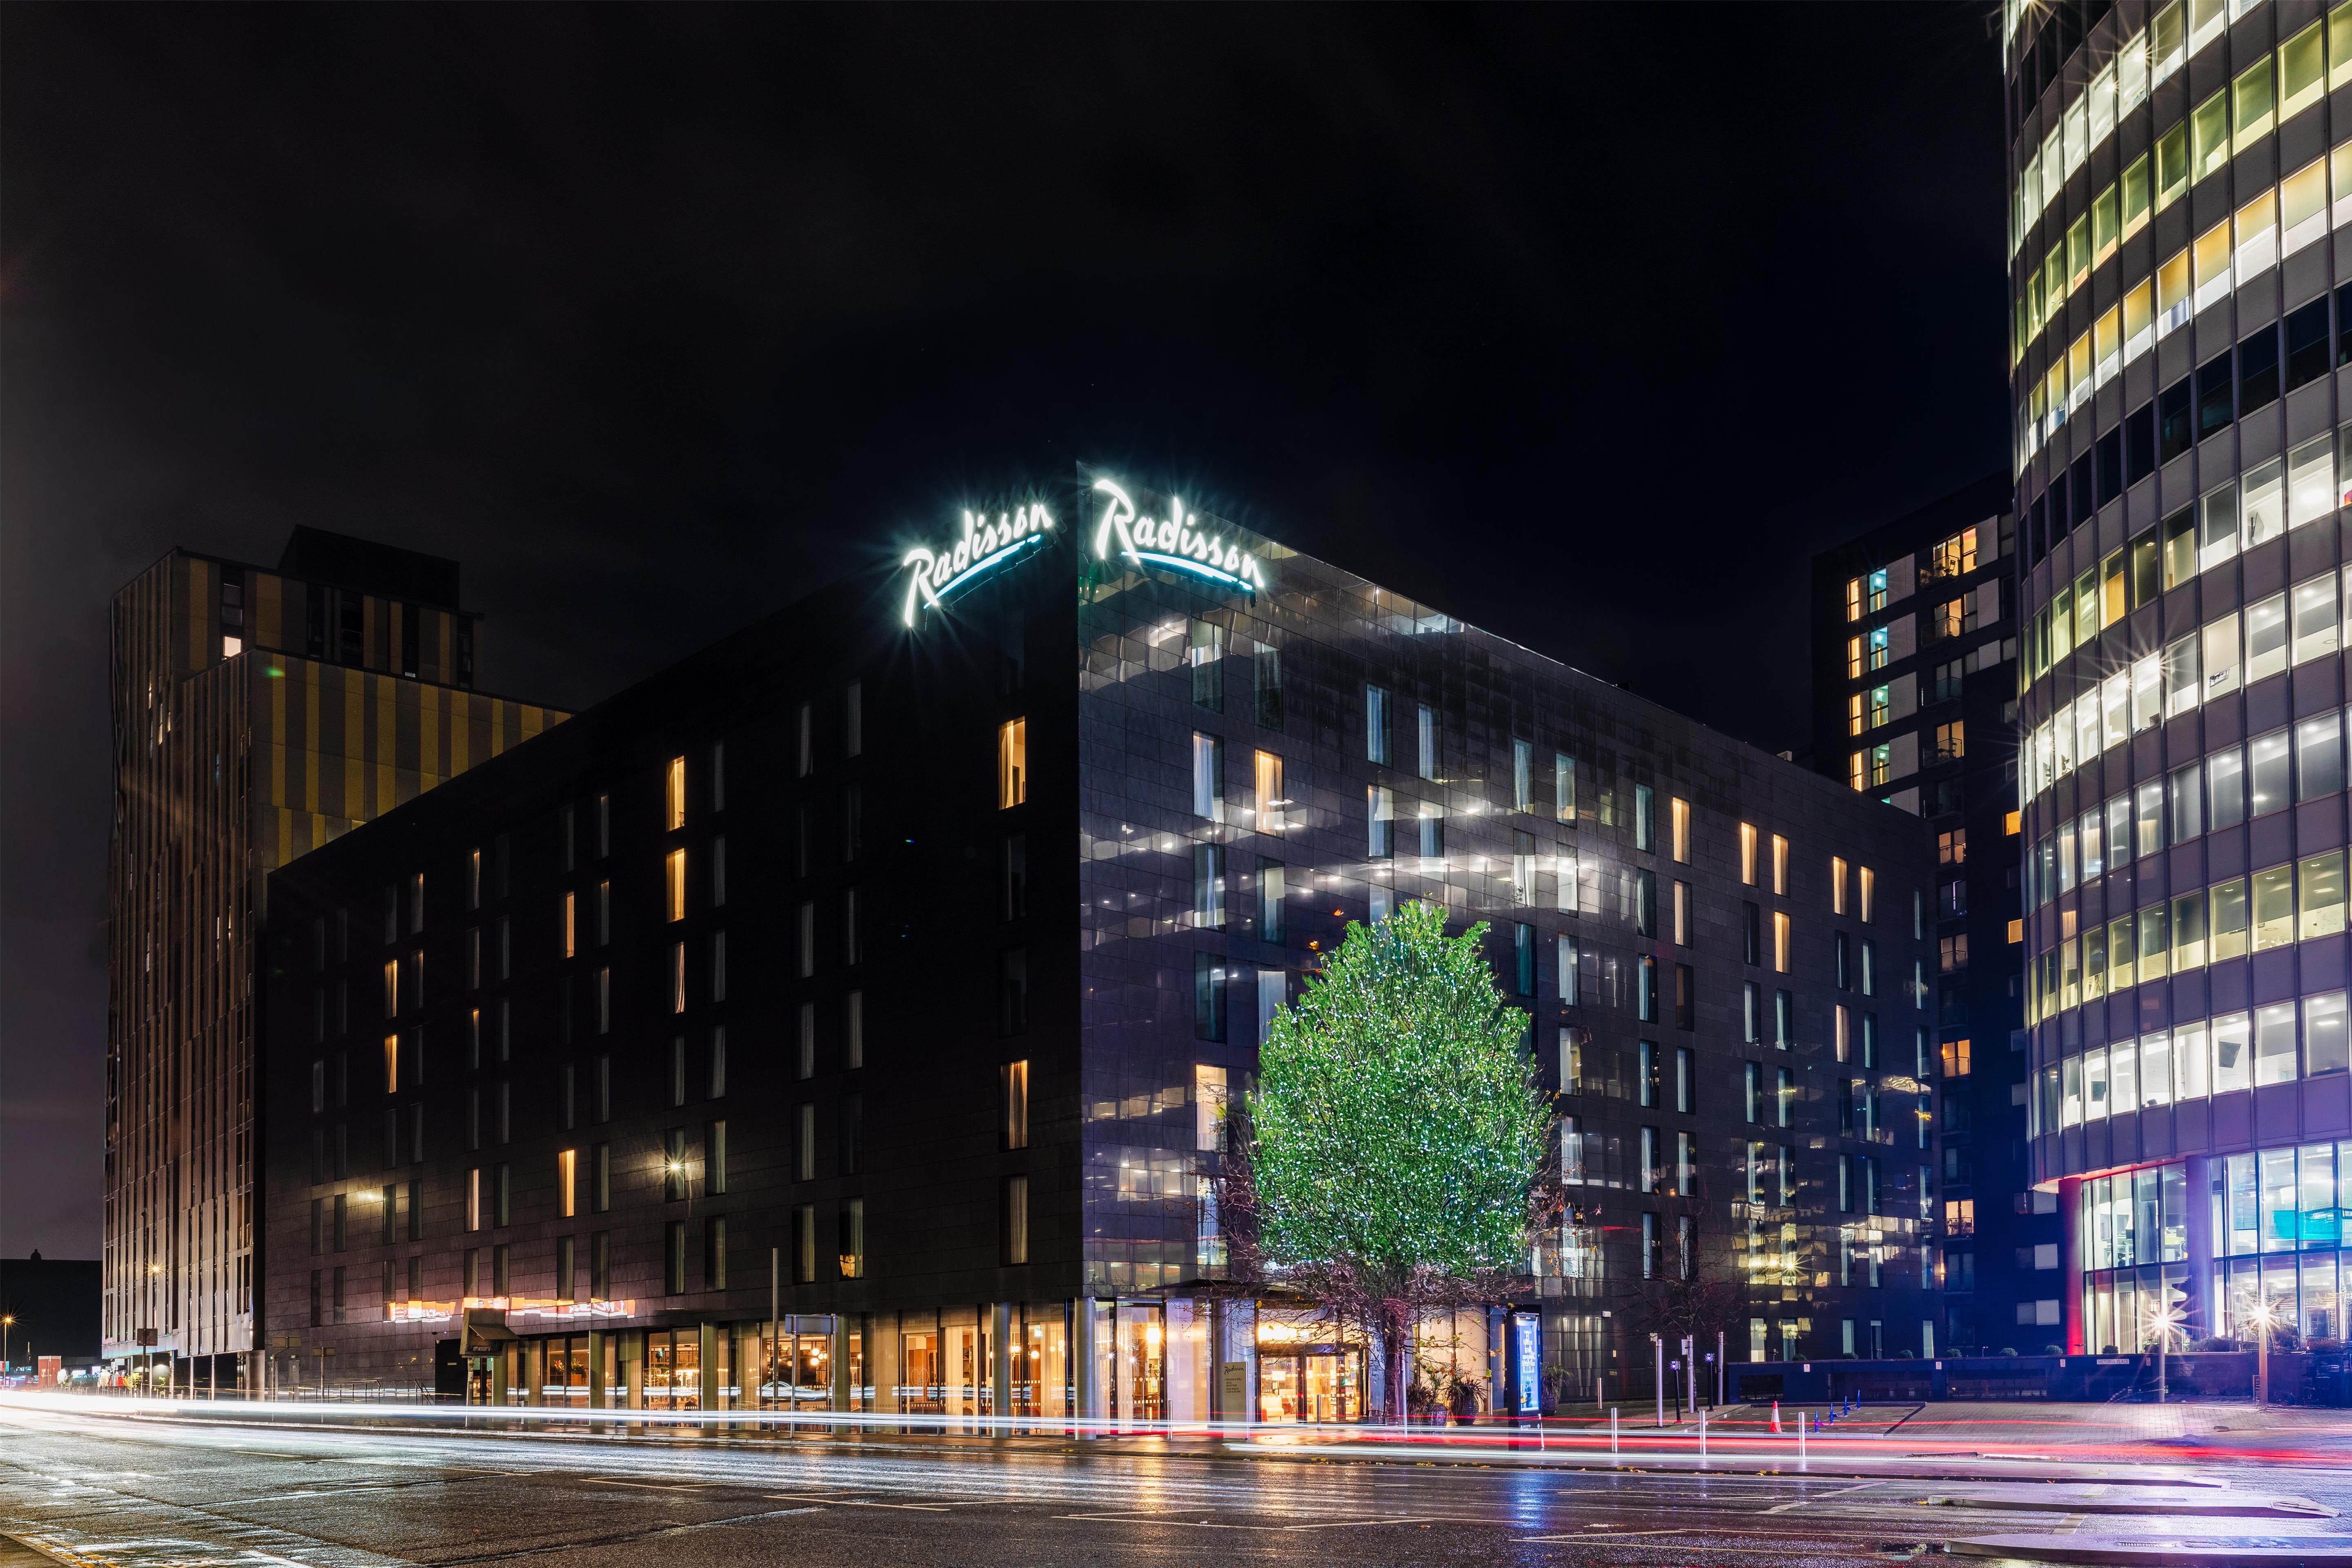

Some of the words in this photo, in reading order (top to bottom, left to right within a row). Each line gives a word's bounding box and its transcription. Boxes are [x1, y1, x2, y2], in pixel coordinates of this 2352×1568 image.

[904, 505, 1052, 627] Radisson
[1095, 479, 1265, 588] Radisson
[1224, 1365, 1244, 1375] Radisson
